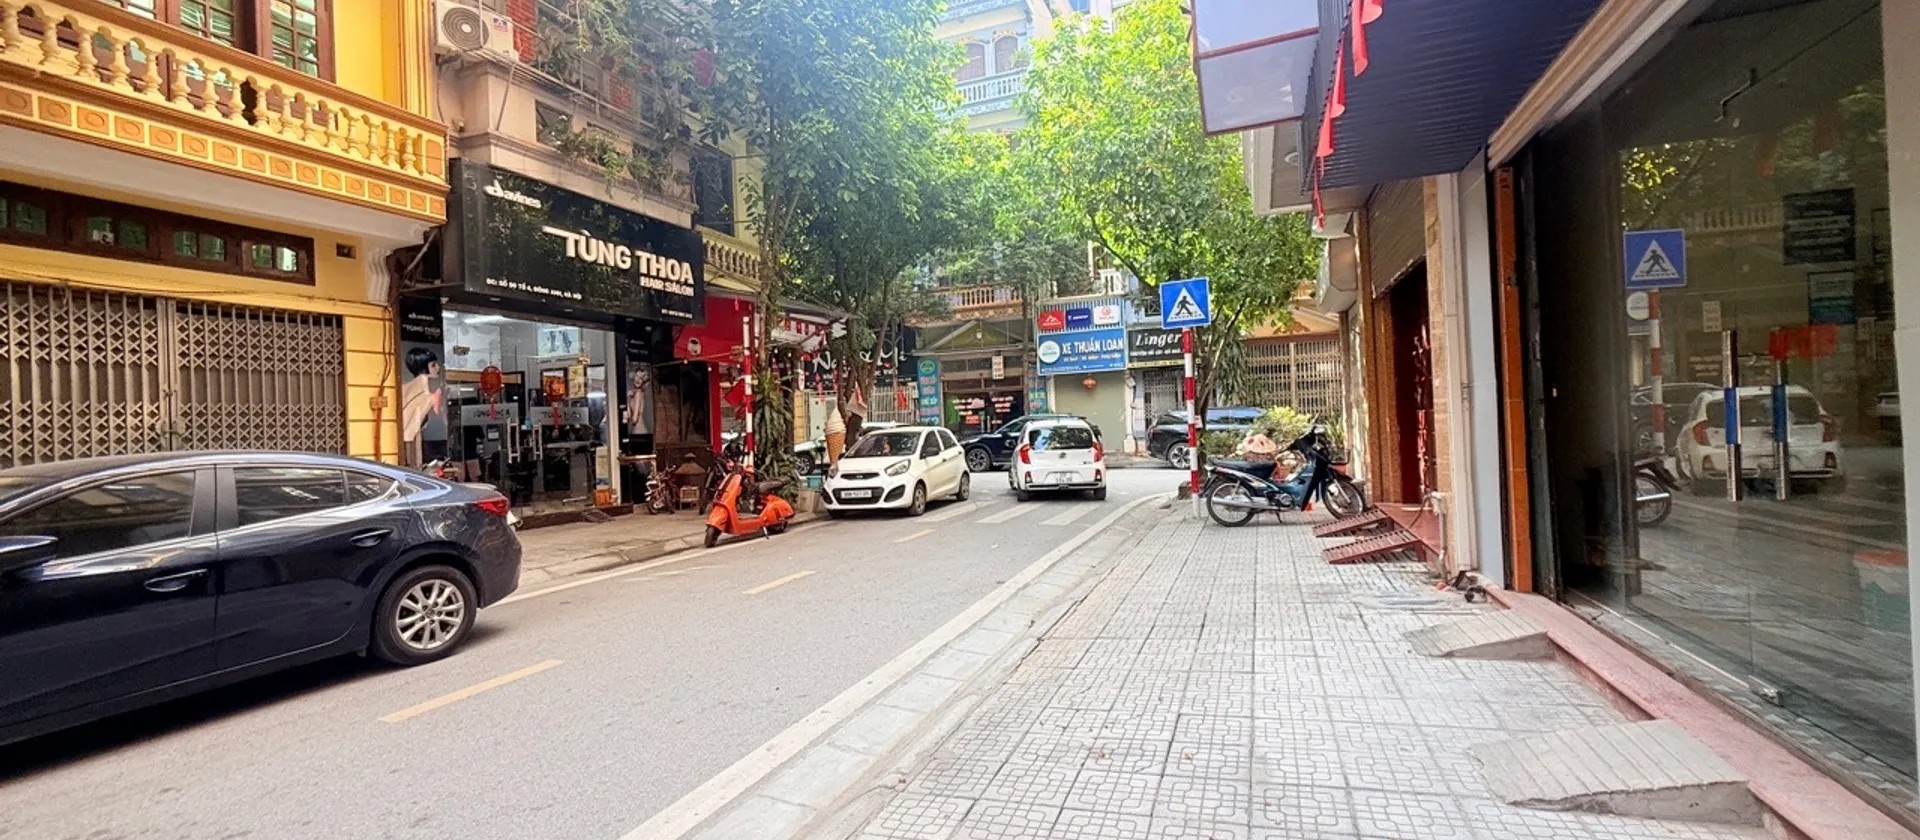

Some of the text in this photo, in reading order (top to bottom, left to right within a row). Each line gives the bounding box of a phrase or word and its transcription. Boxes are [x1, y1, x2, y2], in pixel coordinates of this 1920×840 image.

[541, 225, 695, 285] TÙNG THOA
[639, 276, 664, 291] HAIR
[1062, 342, 1072, 354] XE
[1102, 338, 1124, 352] LOAN
